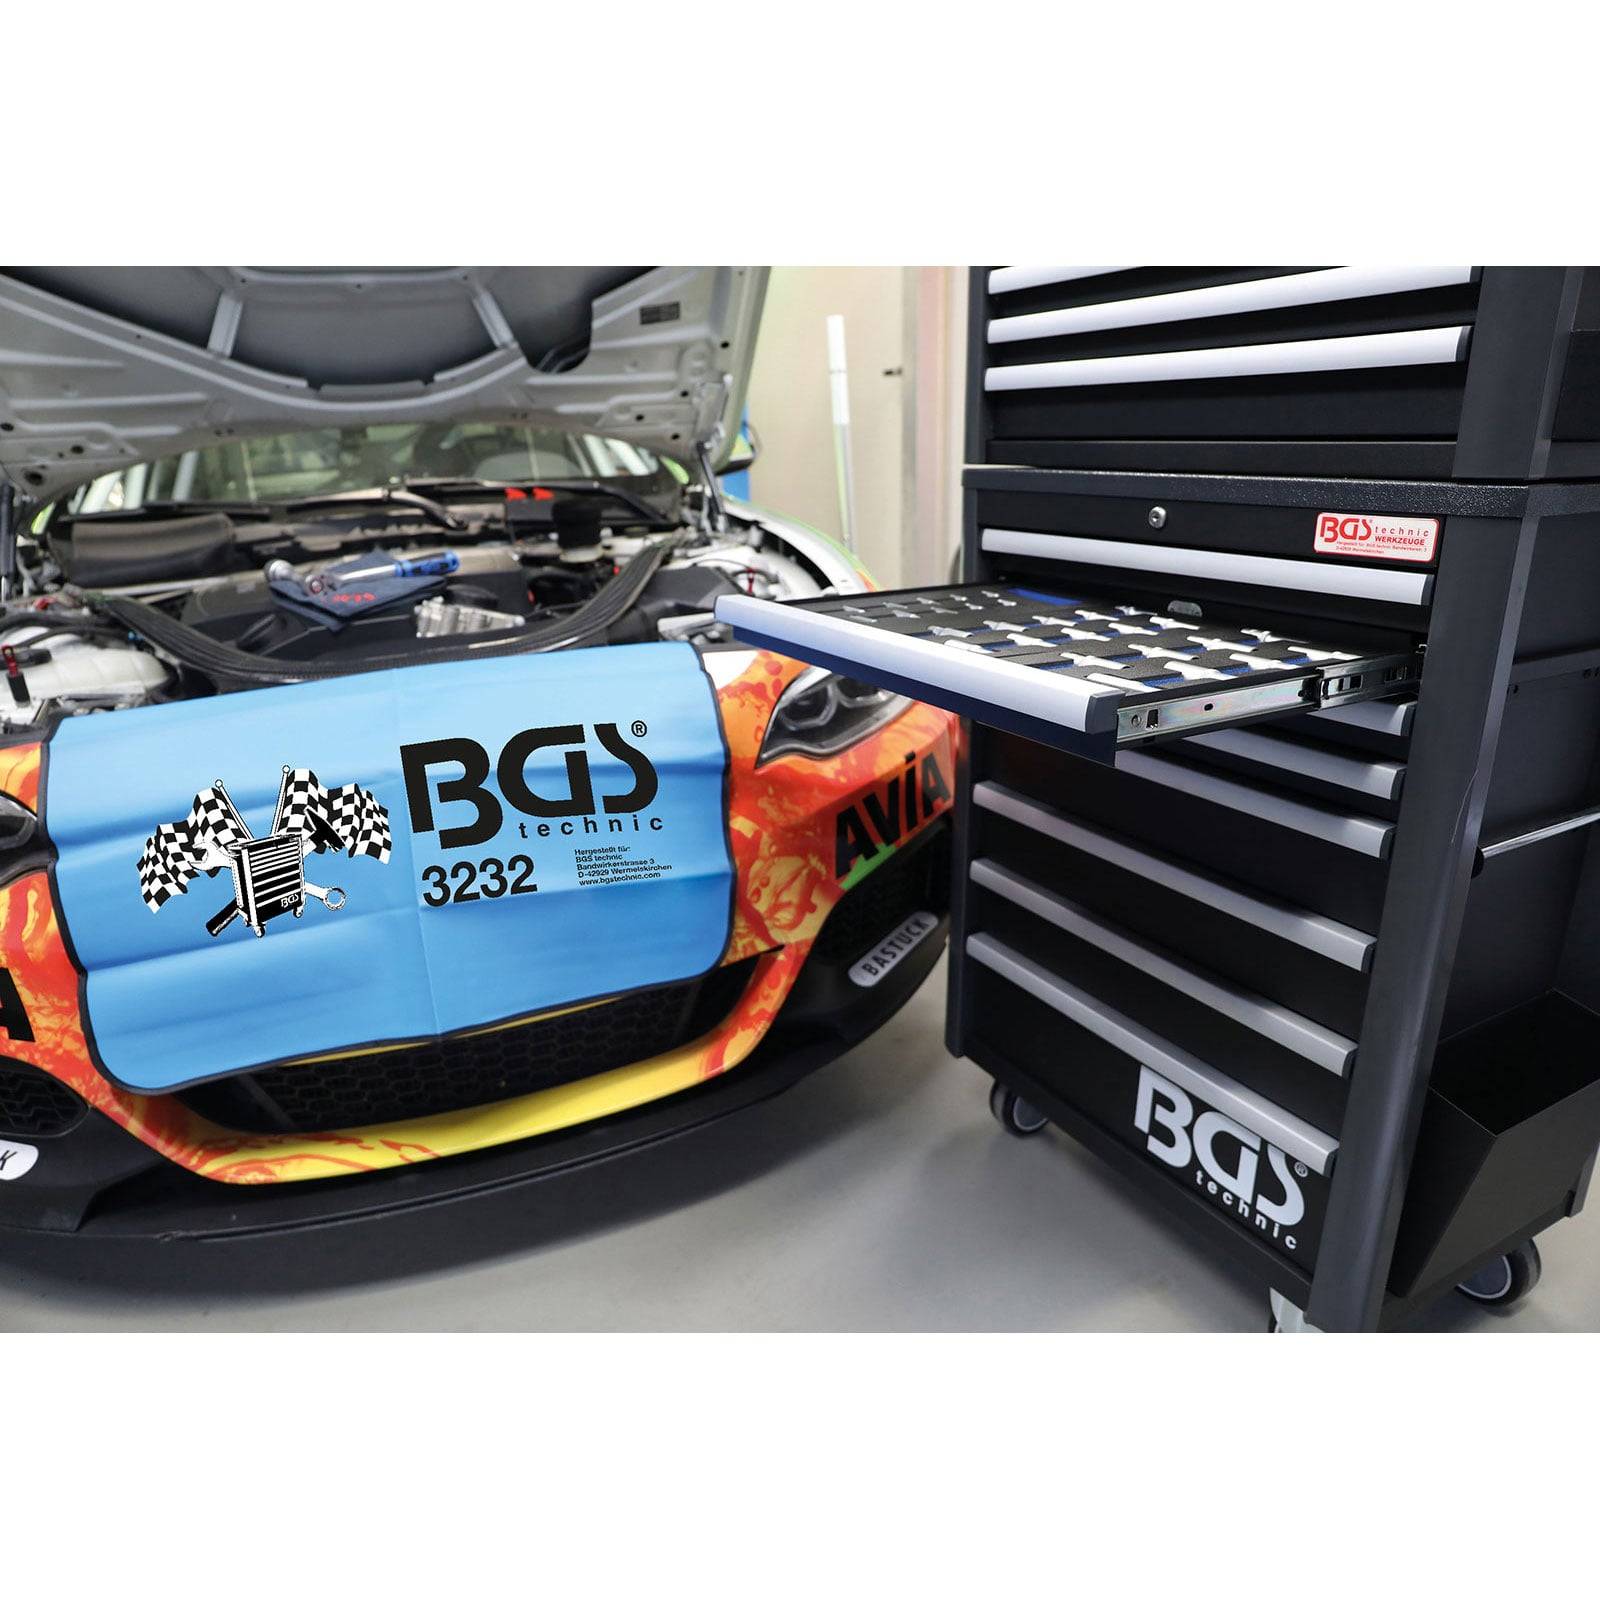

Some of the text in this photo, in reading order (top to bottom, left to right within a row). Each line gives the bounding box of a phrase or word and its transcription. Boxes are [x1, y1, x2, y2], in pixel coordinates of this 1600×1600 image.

[1320, 516, 1372, 543] BGS
[1374, 535, 1425, 546] WERKZEUGE
[1375, 526, 1430, 537] technic
[400, 723, 658, 850] BGS
[518, 814, 663, 839] technic
[576, 855, 593, 863] BGS
[421, 854, 538, 908] 3232
[861, 917, 930, 977] BASTUCK
[1134, 1064, 1305, 1226] BGS
[1195, 1169, 1298, 1250] technic
